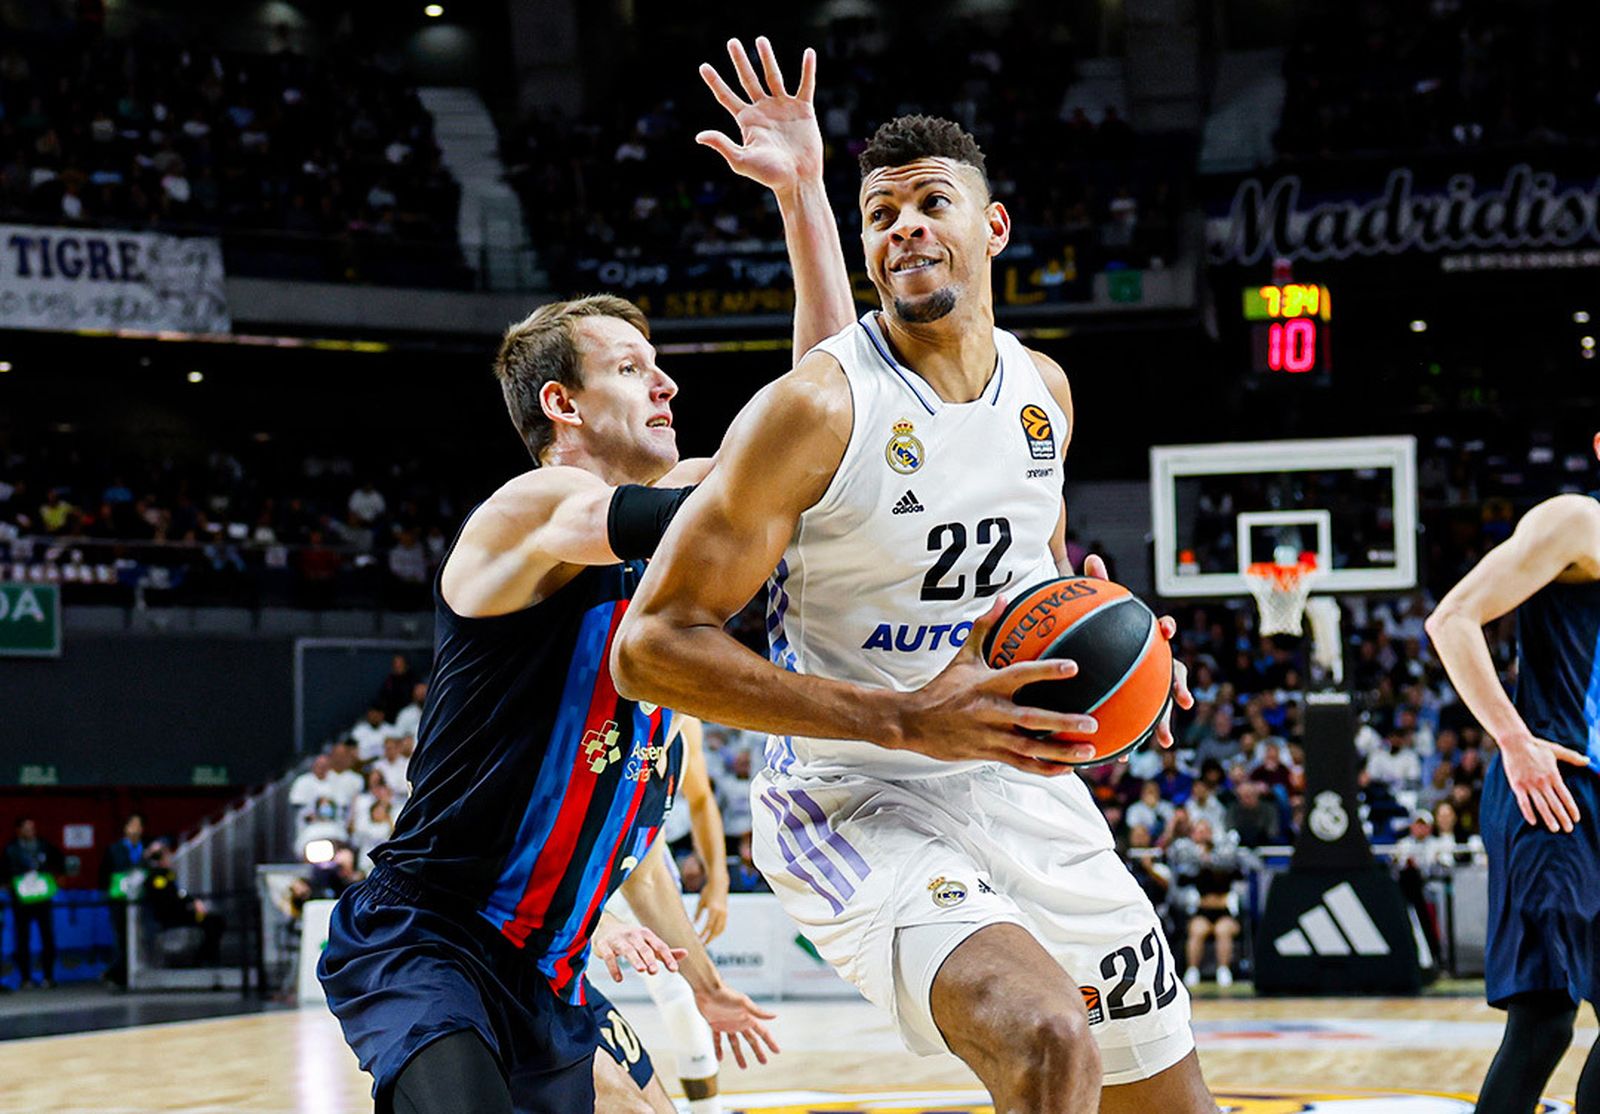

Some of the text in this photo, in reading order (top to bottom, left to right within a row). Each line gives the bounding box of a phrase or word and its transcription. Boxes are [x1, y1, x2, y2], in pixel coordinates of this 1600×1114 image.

[1206, 164, 1600, 266] Madridis
[10, 234, 147, 284] TIGRE
[1268, 318, 1316, 373] 10
[892, 504, 925, 515] adidas
[919, 516, 1013, 601] 22
[861, 621, 975, 653] AUTO
[992, 579, 1098, 670] SPALDING
[1099, 927, 1178, 1021] 22
